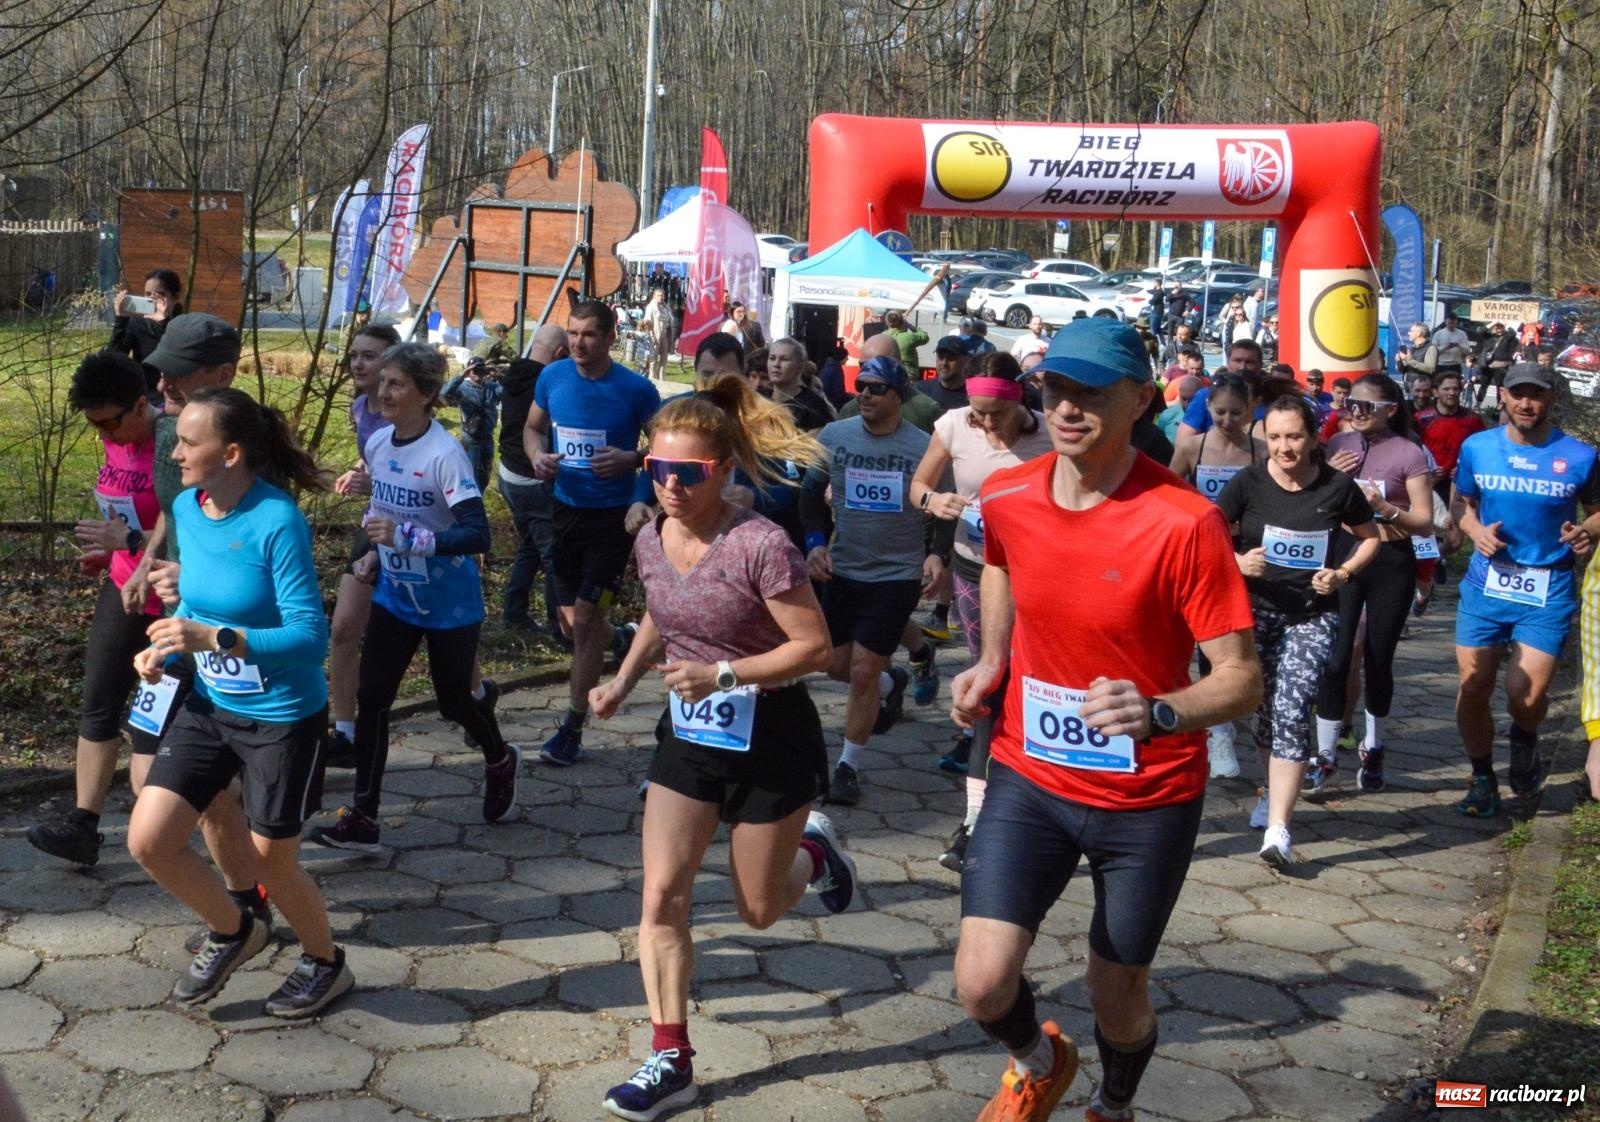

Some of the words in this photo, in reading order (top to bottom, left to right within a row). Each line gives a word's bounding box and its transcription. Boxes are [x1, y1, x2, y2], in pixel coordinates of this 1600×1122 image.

[1079, 136, 1142, 150] BIEG
[1028, 159, 1195, 180] TWARDZIELA
[1040, 185, 1177, 207] RACIBÓRZ
[386, 140, 419, 274] RACIBÓRZ
[1484, 302, 1523, 312] VAMOS
[566, 442, 594, 458] 019
[833, 446, 913, 474] CrossFit
[855, 484, 891, 501] 069
[1206, 479, 1229, 496] 07
[1473, 474, 1578, 497] RUNNERS
[1273, 542, 1315, 558] 068
[1498, 573, 1535, 593] 036
[680, 699, 736, 728] 049
[1039, 711, 1110, 748] 086
